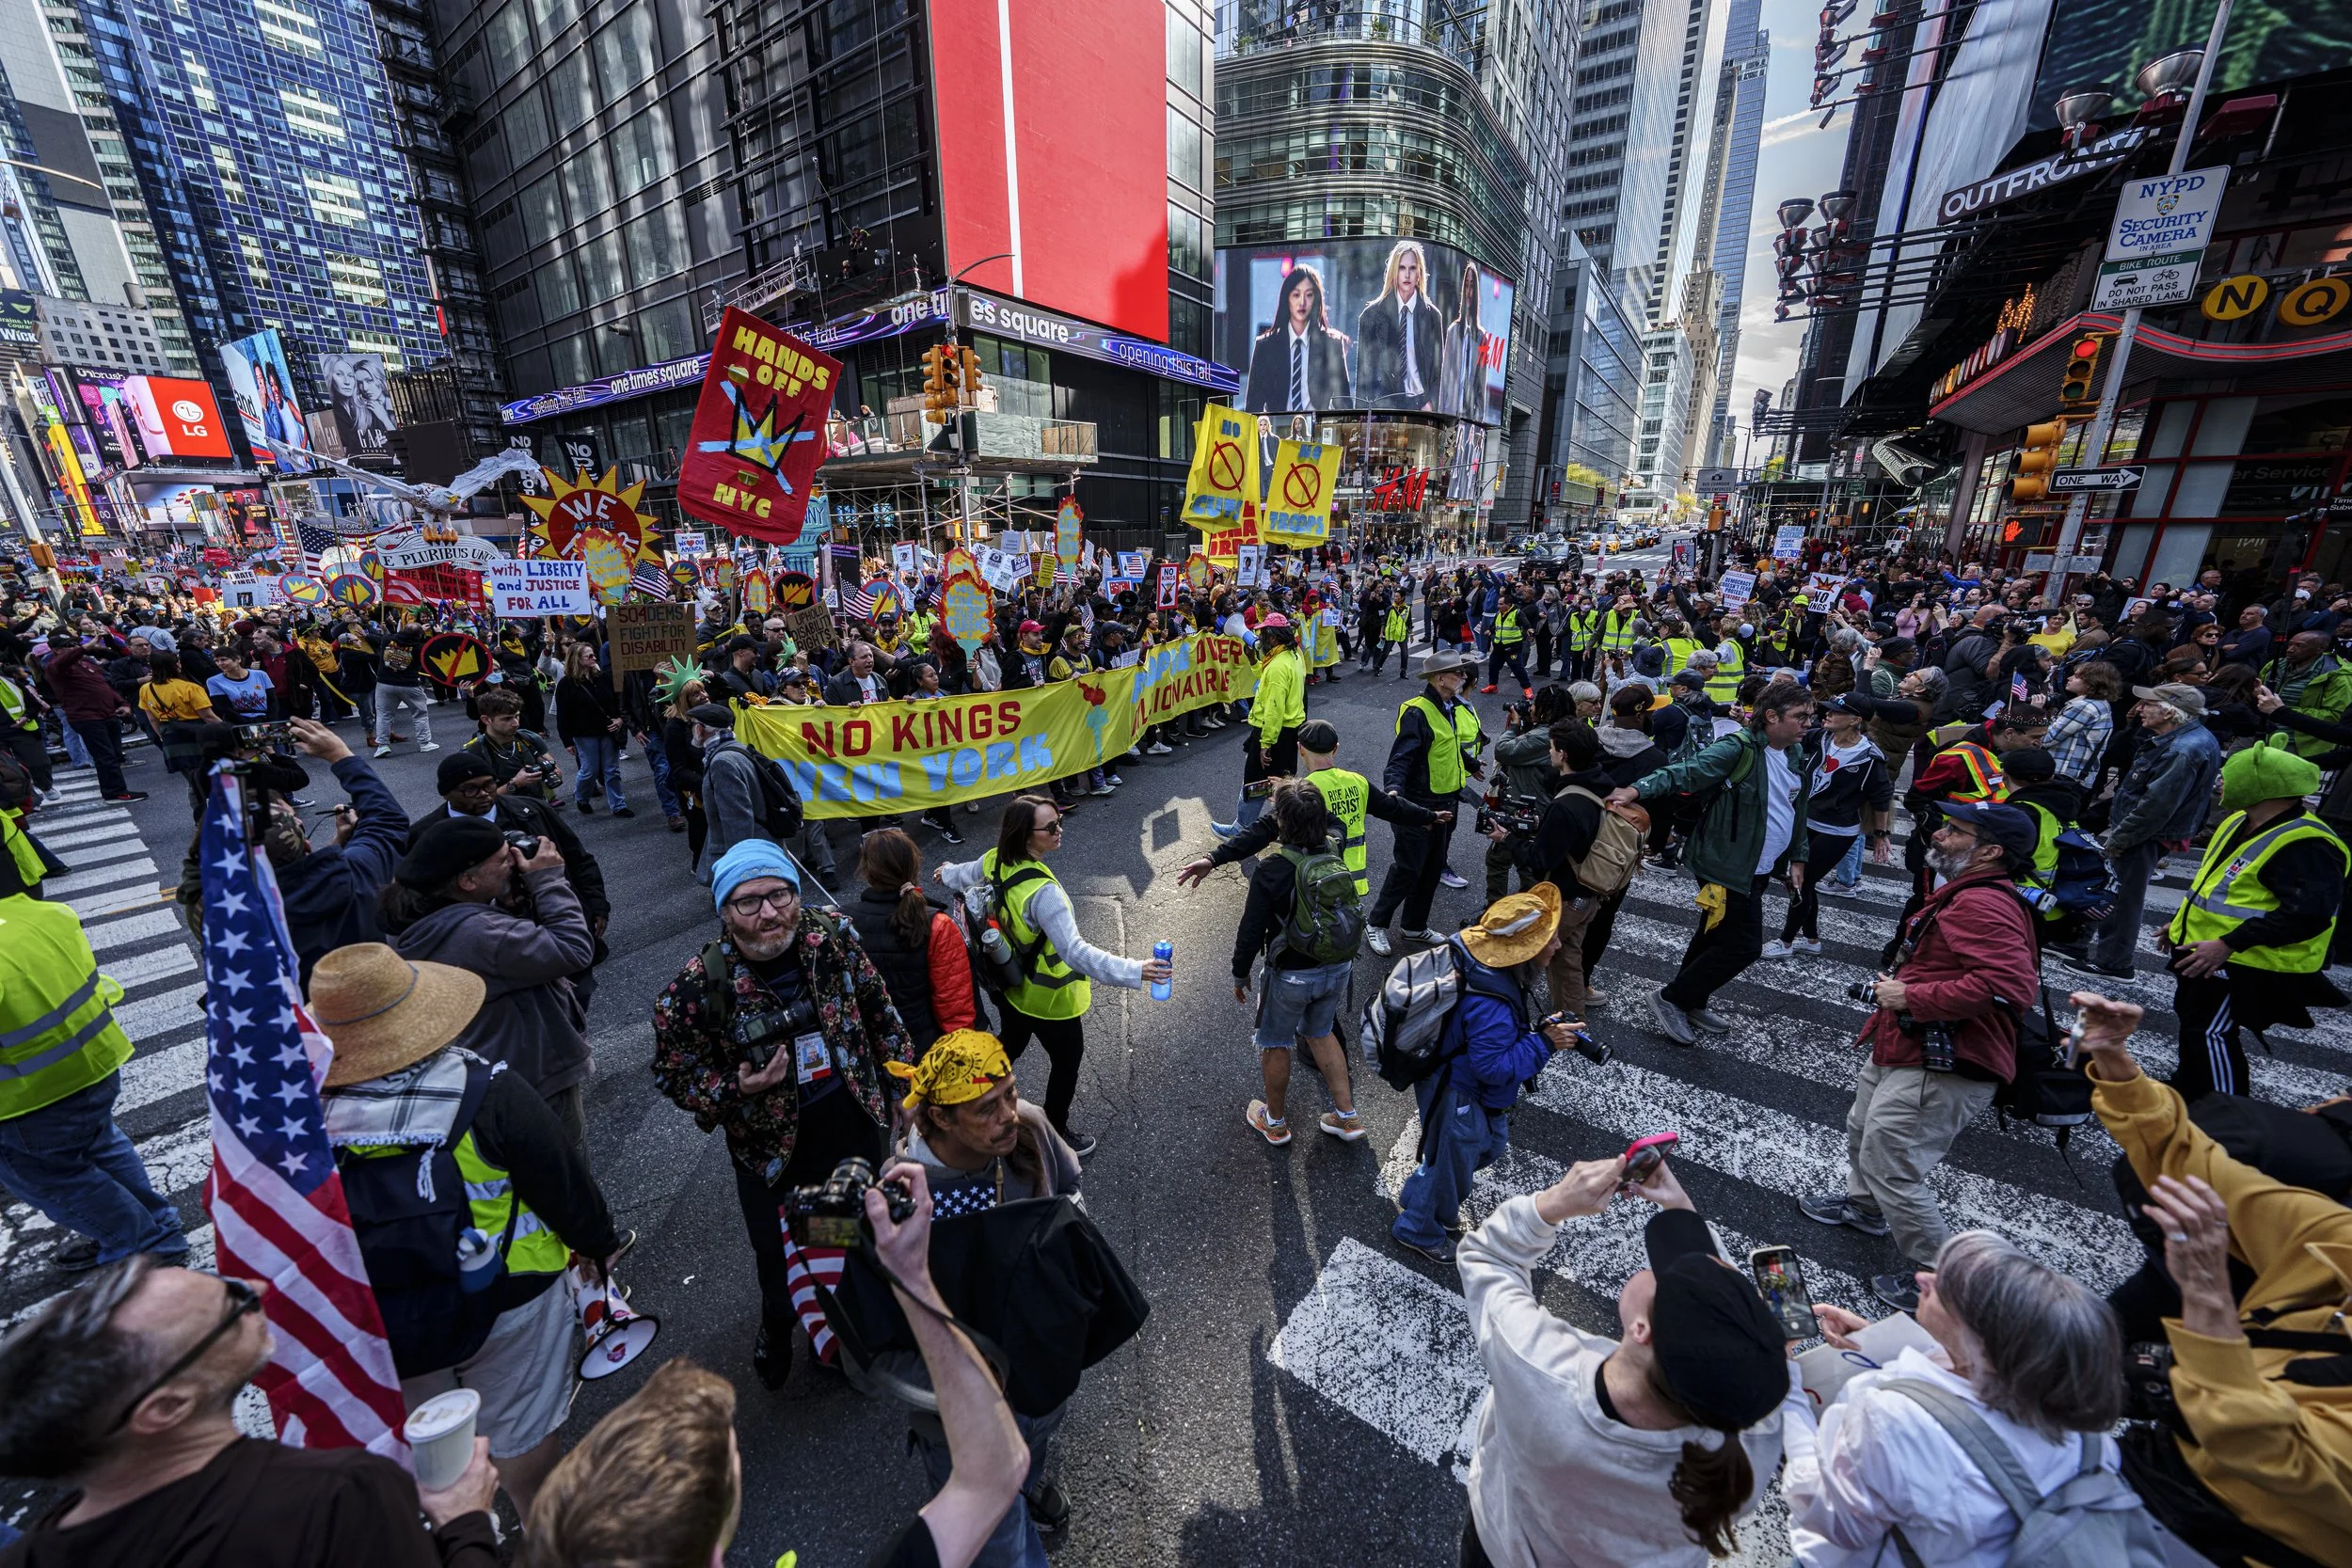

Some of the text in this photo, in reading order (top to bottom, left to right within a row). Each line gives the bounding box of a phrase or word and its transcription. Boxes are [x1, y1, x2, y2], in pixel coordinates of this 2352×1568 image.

[2139, 176, 2205, 198] NYPD
[2119, 211, 2208, 234] SECURITY
[2120, 227, 2197, 247] CAMERA
[2150, 243, 2171, 251] AREA
[2120, 254, 2182, 271] BIKE ROUTE
[2108, 282, 2178, 298] DO NOT PASS
[2217, 282, 2258, 313] N
[2097, 291, 2185, 309] IN SHARED LANE
[2296, 286, 2336, 317] Q
[891, 300, 928, 325] one
[1000, 309, 1069, 342] square
[816, 325, 837, 345] fall
[732, 325, 831, 390] HANDS
[1120, 341, 1212, 381] opening this fall
[1477, 332, 1505, 373] H&M
[612, 359, 700, 394] one times square
[756, 364, 803, 398] OFF
[532, 387, 585, 417] opening this fall
[182, 424, 208, 437] LG
[1221, 419, 1241, 438] NO
[358, 429, 387, 448] GAP
[511, 436, 532, 449] NO
[564, 441, 592, 458] NO
[1298, 444, 1323, 460] NO
[1374, 467, 1430, 511] H&M
[2059, 474, 2130, 485] ONE WAY
[560, 492, 617, 520] WE
[713, 482, 771, 518] NYC
[1191, 494, 1244, 521] CUTS
[573, 520, 615, 531] ARE THE
[1269, 511, 1325, 535] TROOPS
[383, 556, 394, 566] E
[401, 547, 469, 565] PLURIBUS
[1013, 556, 1025, 564] FOX
[398, 570, 417, 579] ARE
[420, 570, 467, 586] STEALING
[491, 564, 521, 577] with
[527, 562, 584, 578] LIBERTY
[424, 583, 450, 594] FROM
[497, 579, 580, 592] and JUSTICE
[1724, 578, 1752, 587] DEMOCRACY
[507, 594, 570, 610] FOR ALL
[1815, 593, 1828, 604] NO
[795, 605, 823, 626] UPHOLD
[620, 625, 686, 641] FIGHT FOR
[792, 618, 832, 641] DISABILITY
[621, 639, 687, 656] DISABILITY
[797, 629, 832, 651] RIGHTS
[1196, 637, 1242, 665] OVER
[802, 701, 1022, 758] NO KINGS
[774, 732, 1054, 802] NEW YORK
[1328, 786, 1359, 801] RISE AND
[1332, 797, 1360, 816] RESIST
[1347, 814, 1361, 828] .org
